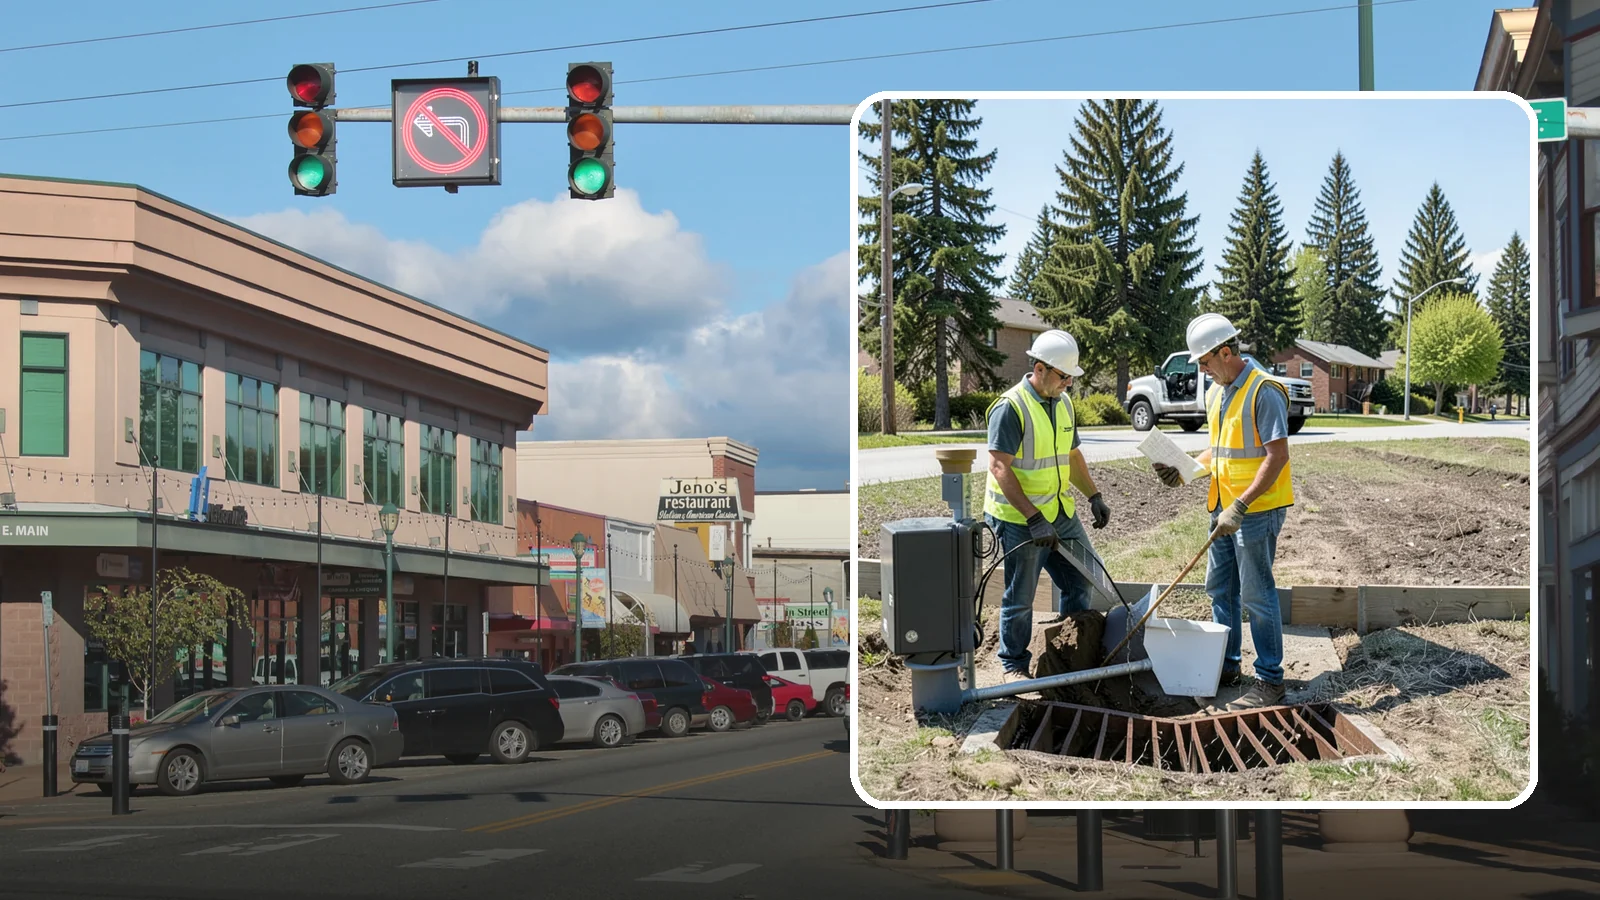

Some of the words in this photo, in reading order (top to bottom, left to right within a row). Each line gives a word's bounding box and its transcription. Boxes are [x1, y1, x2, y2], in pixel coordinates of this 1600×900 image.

[669, 480, 728, 494] Jeno's
[665, 496, 731, 509] restaurant
[686, 509, 714, 519] American
[714, 509, 738, 519] Cuisine
[2, 525, 13, 536] E.
[15, 525, 49, 536] MAIN
[797, 607, 828, 617] Street
